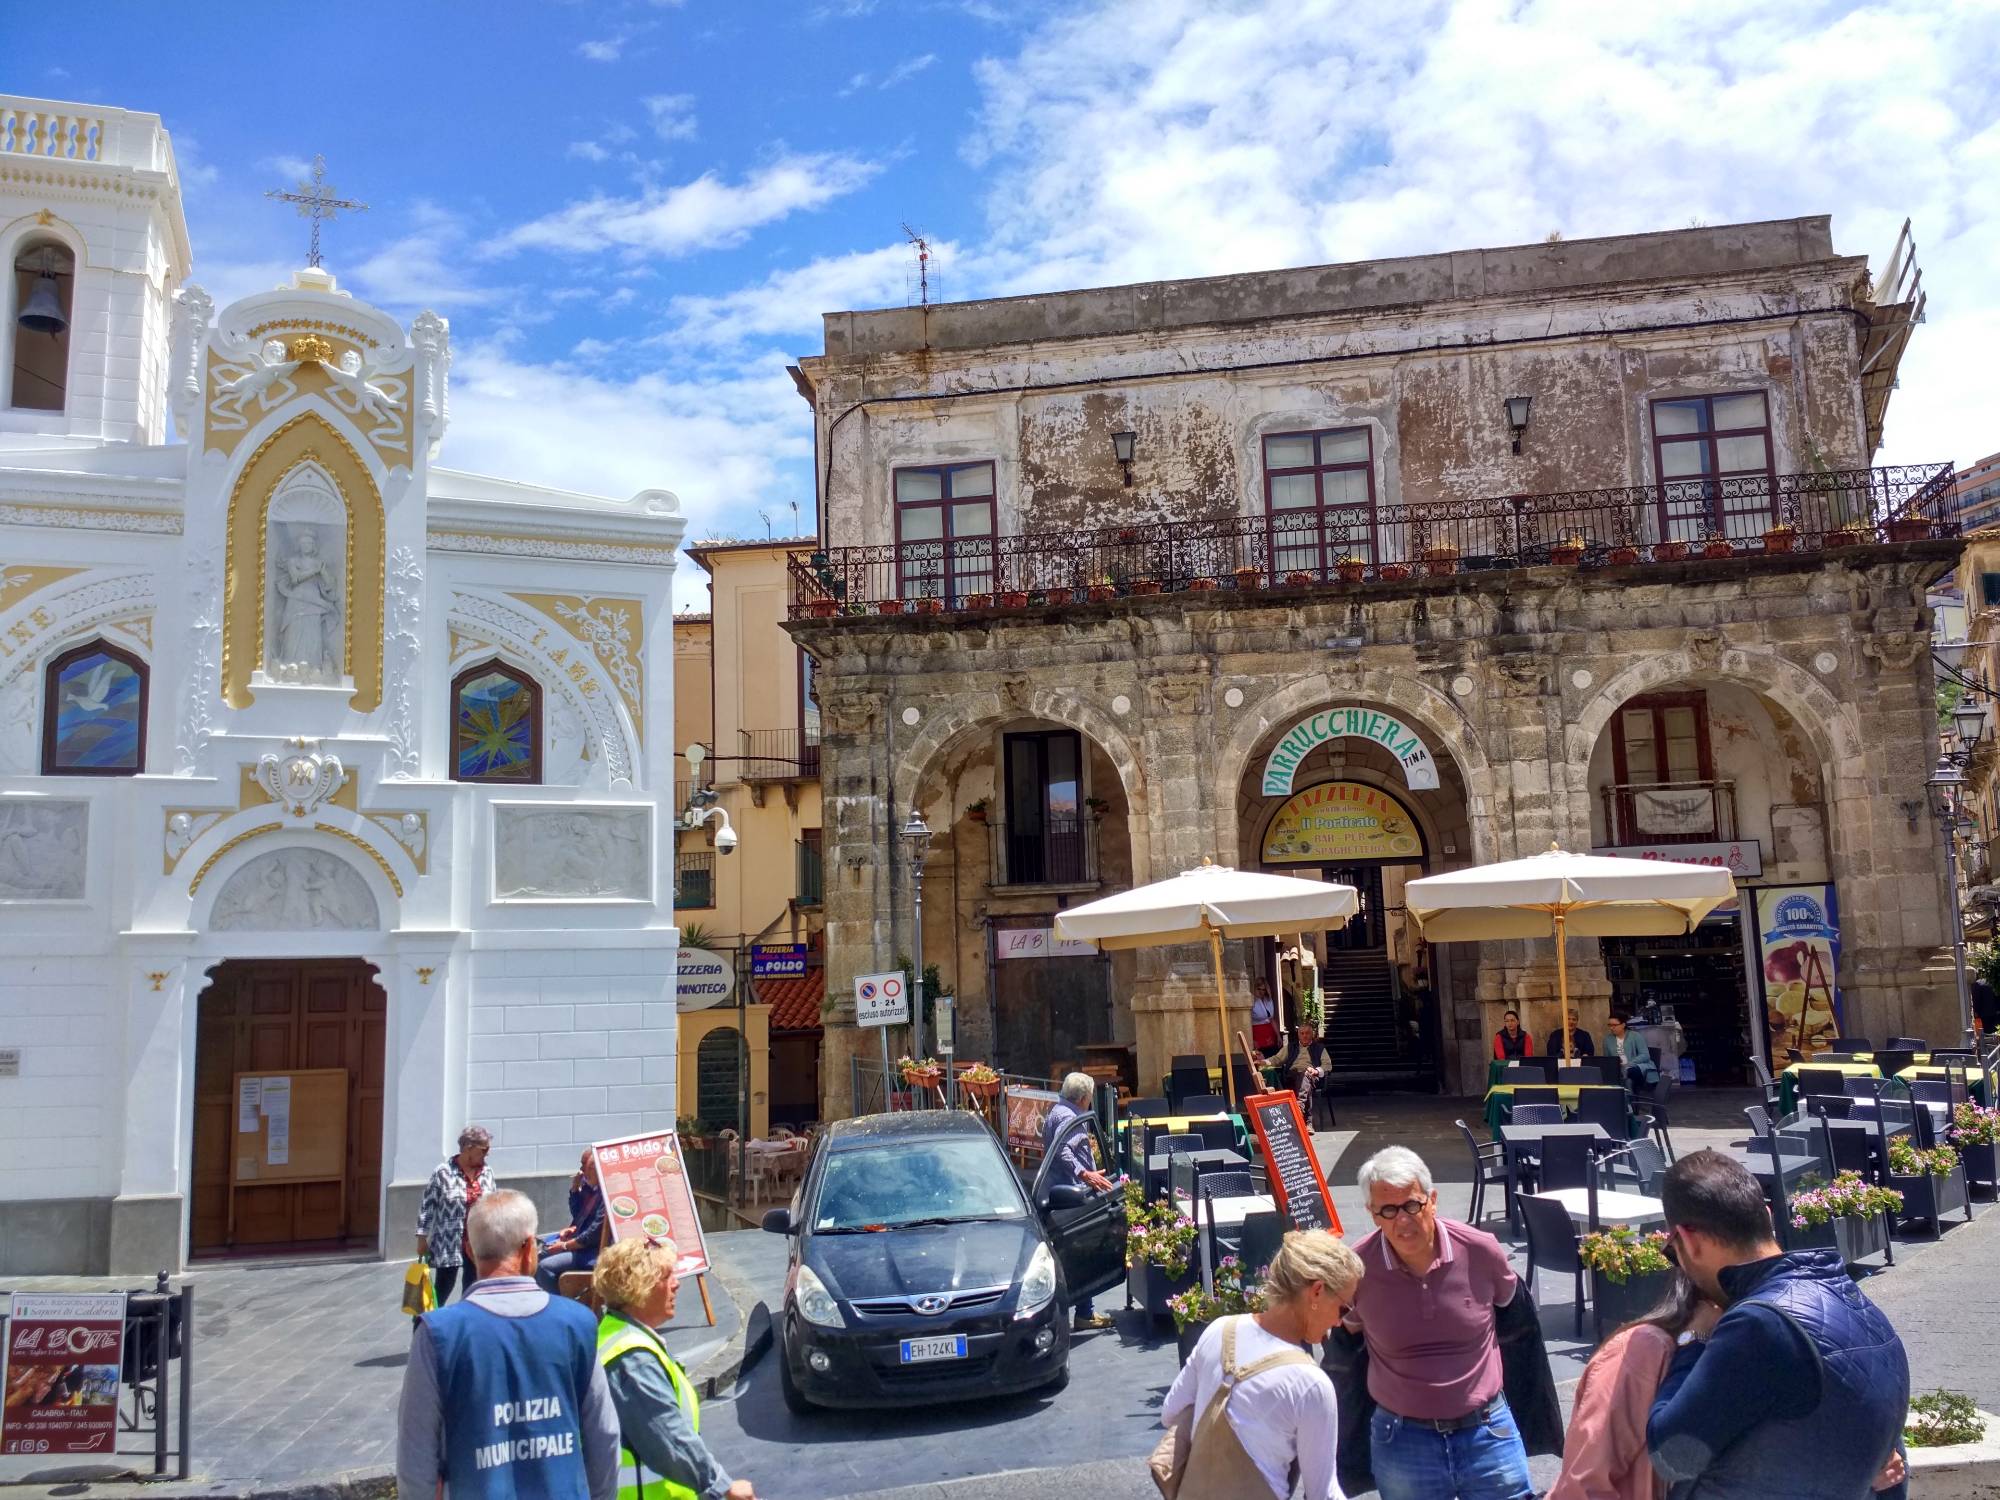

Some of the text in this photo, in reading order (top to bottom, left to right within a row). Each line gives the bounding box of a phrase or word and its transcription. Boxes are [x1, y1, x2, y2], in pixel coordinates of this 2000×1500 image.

[1264, 708, 1418, 794] PARRUCCHIERA
[1402, 749, 1427, 769] TINA
[1315, 815, 1379, 830] Porticato
[1785, 907, 1815, 921] 100%
[1009, 933, 1028, 950] LA
[676, 951, 692, 959] oldo
[761, 945, 794, 953] PIZZERIA
[677, 964, 723, 976] IZZERIA
[754, 960, 804, 972] da POLDO
[677, 983, 727, 995] NINOTECA
[885, 998, 896, 1007] 24
[858, 1009, 880, 1021] escluso
[599, 1147, 620, 1162] da
[622, 1140, 661, 1159] Poldo
[31, 1307, 60, 1318] Sapori
[75, 1305, 119, 1316] Calabria
[14, 1326, 121, 1354] LA BOTTE
[32, 1409, 65, 1417] CALABRIA
[70, 1409, 88, 1417] ITALY
[493, 1396, 562, 1427] POLIZIA
[475, 1432, 574, 1470] MUNICIPALE
